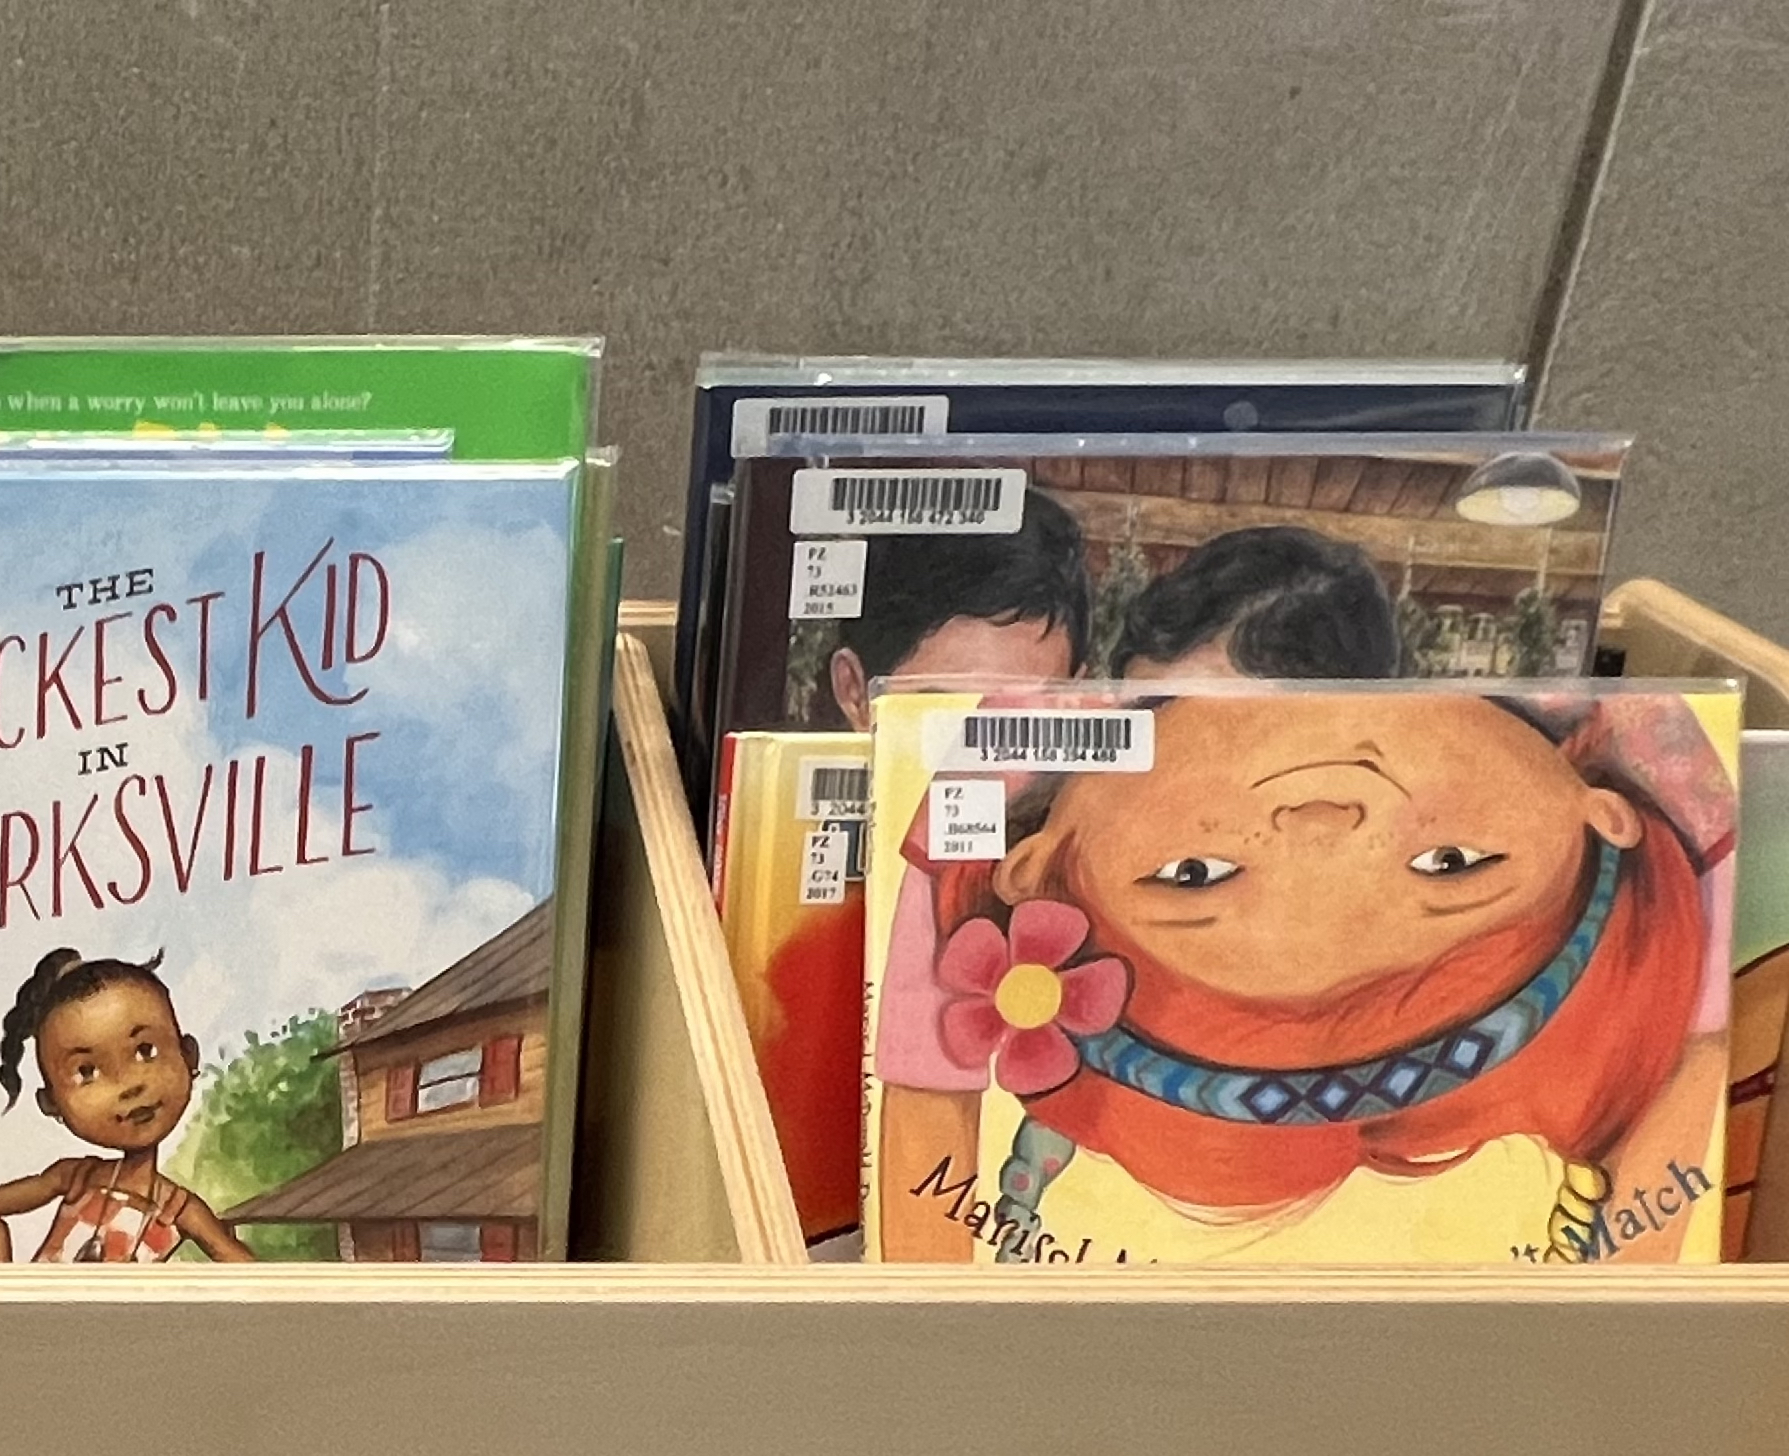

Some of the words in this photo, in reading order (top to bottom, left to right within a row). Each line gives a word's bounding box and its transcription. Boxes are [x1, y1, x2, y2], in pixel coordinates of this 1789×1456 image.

[7, 391, 62, 411] when
[68, 397, 79, 411] a
[86, 396, 145, 416] worry
[152, 391, 204, 411] won't
[213, 391, 262, 411] leave
[268, 397, 304, 416] you
[310, 391, 372, 411] alone?
[56, 568, 155, 610] THE
[246, 537, 391, 720] KID
[77, 743, 130, 776] IN
[1561, 1158, 1714, 1262] Match
